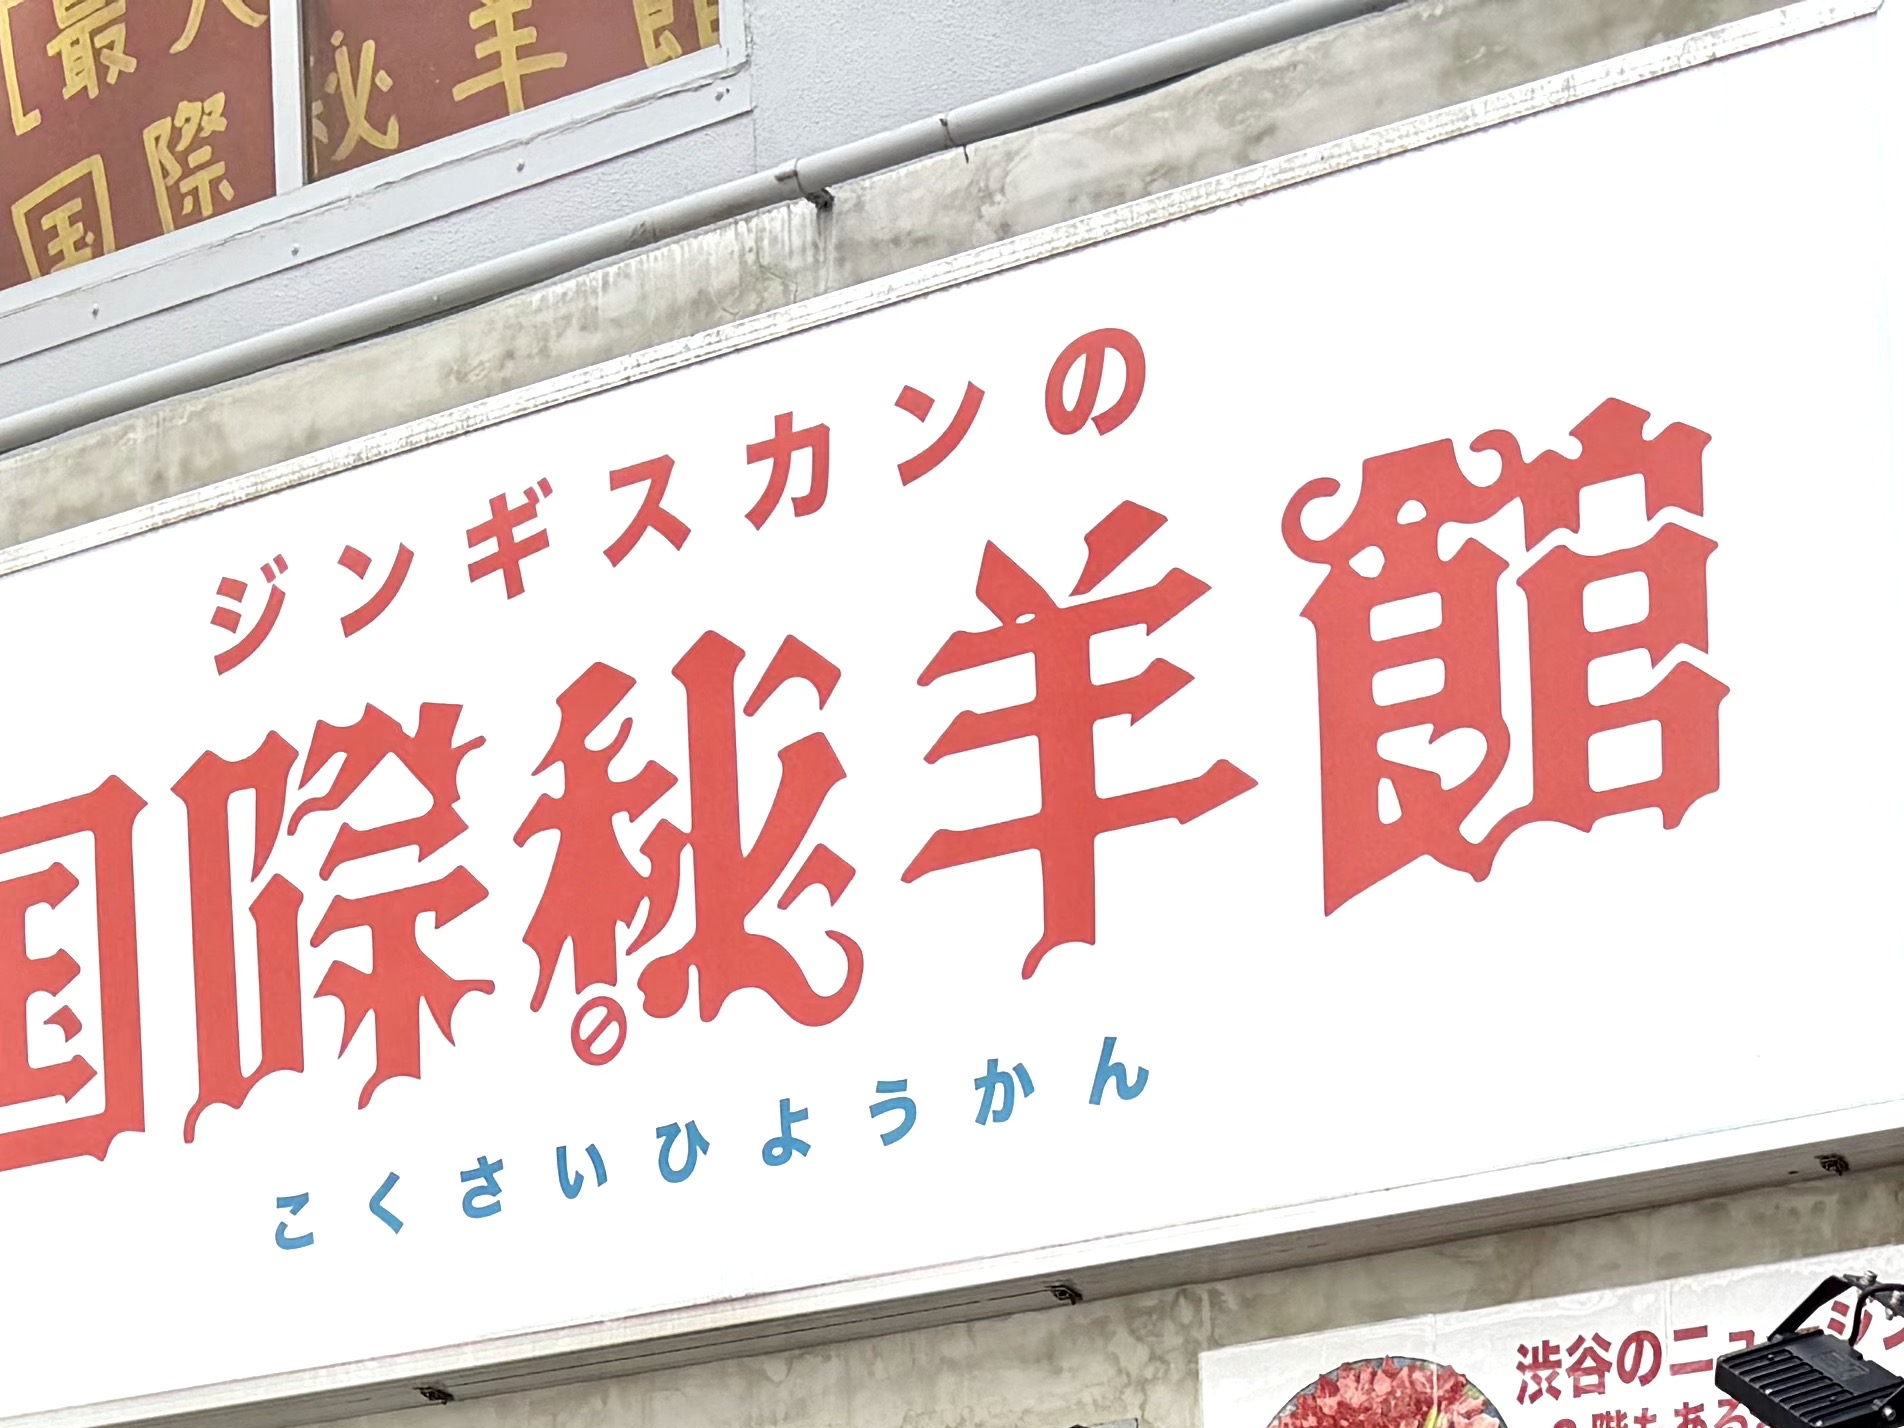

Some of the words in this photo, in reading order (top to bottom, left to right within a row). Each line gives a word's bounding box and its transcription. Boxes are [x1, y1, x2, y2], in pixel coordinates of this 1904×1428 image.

[210, 327, 1147, 676] ジンギスカンの
[274, 1036, 1150, 1252] こくさいひようかん
